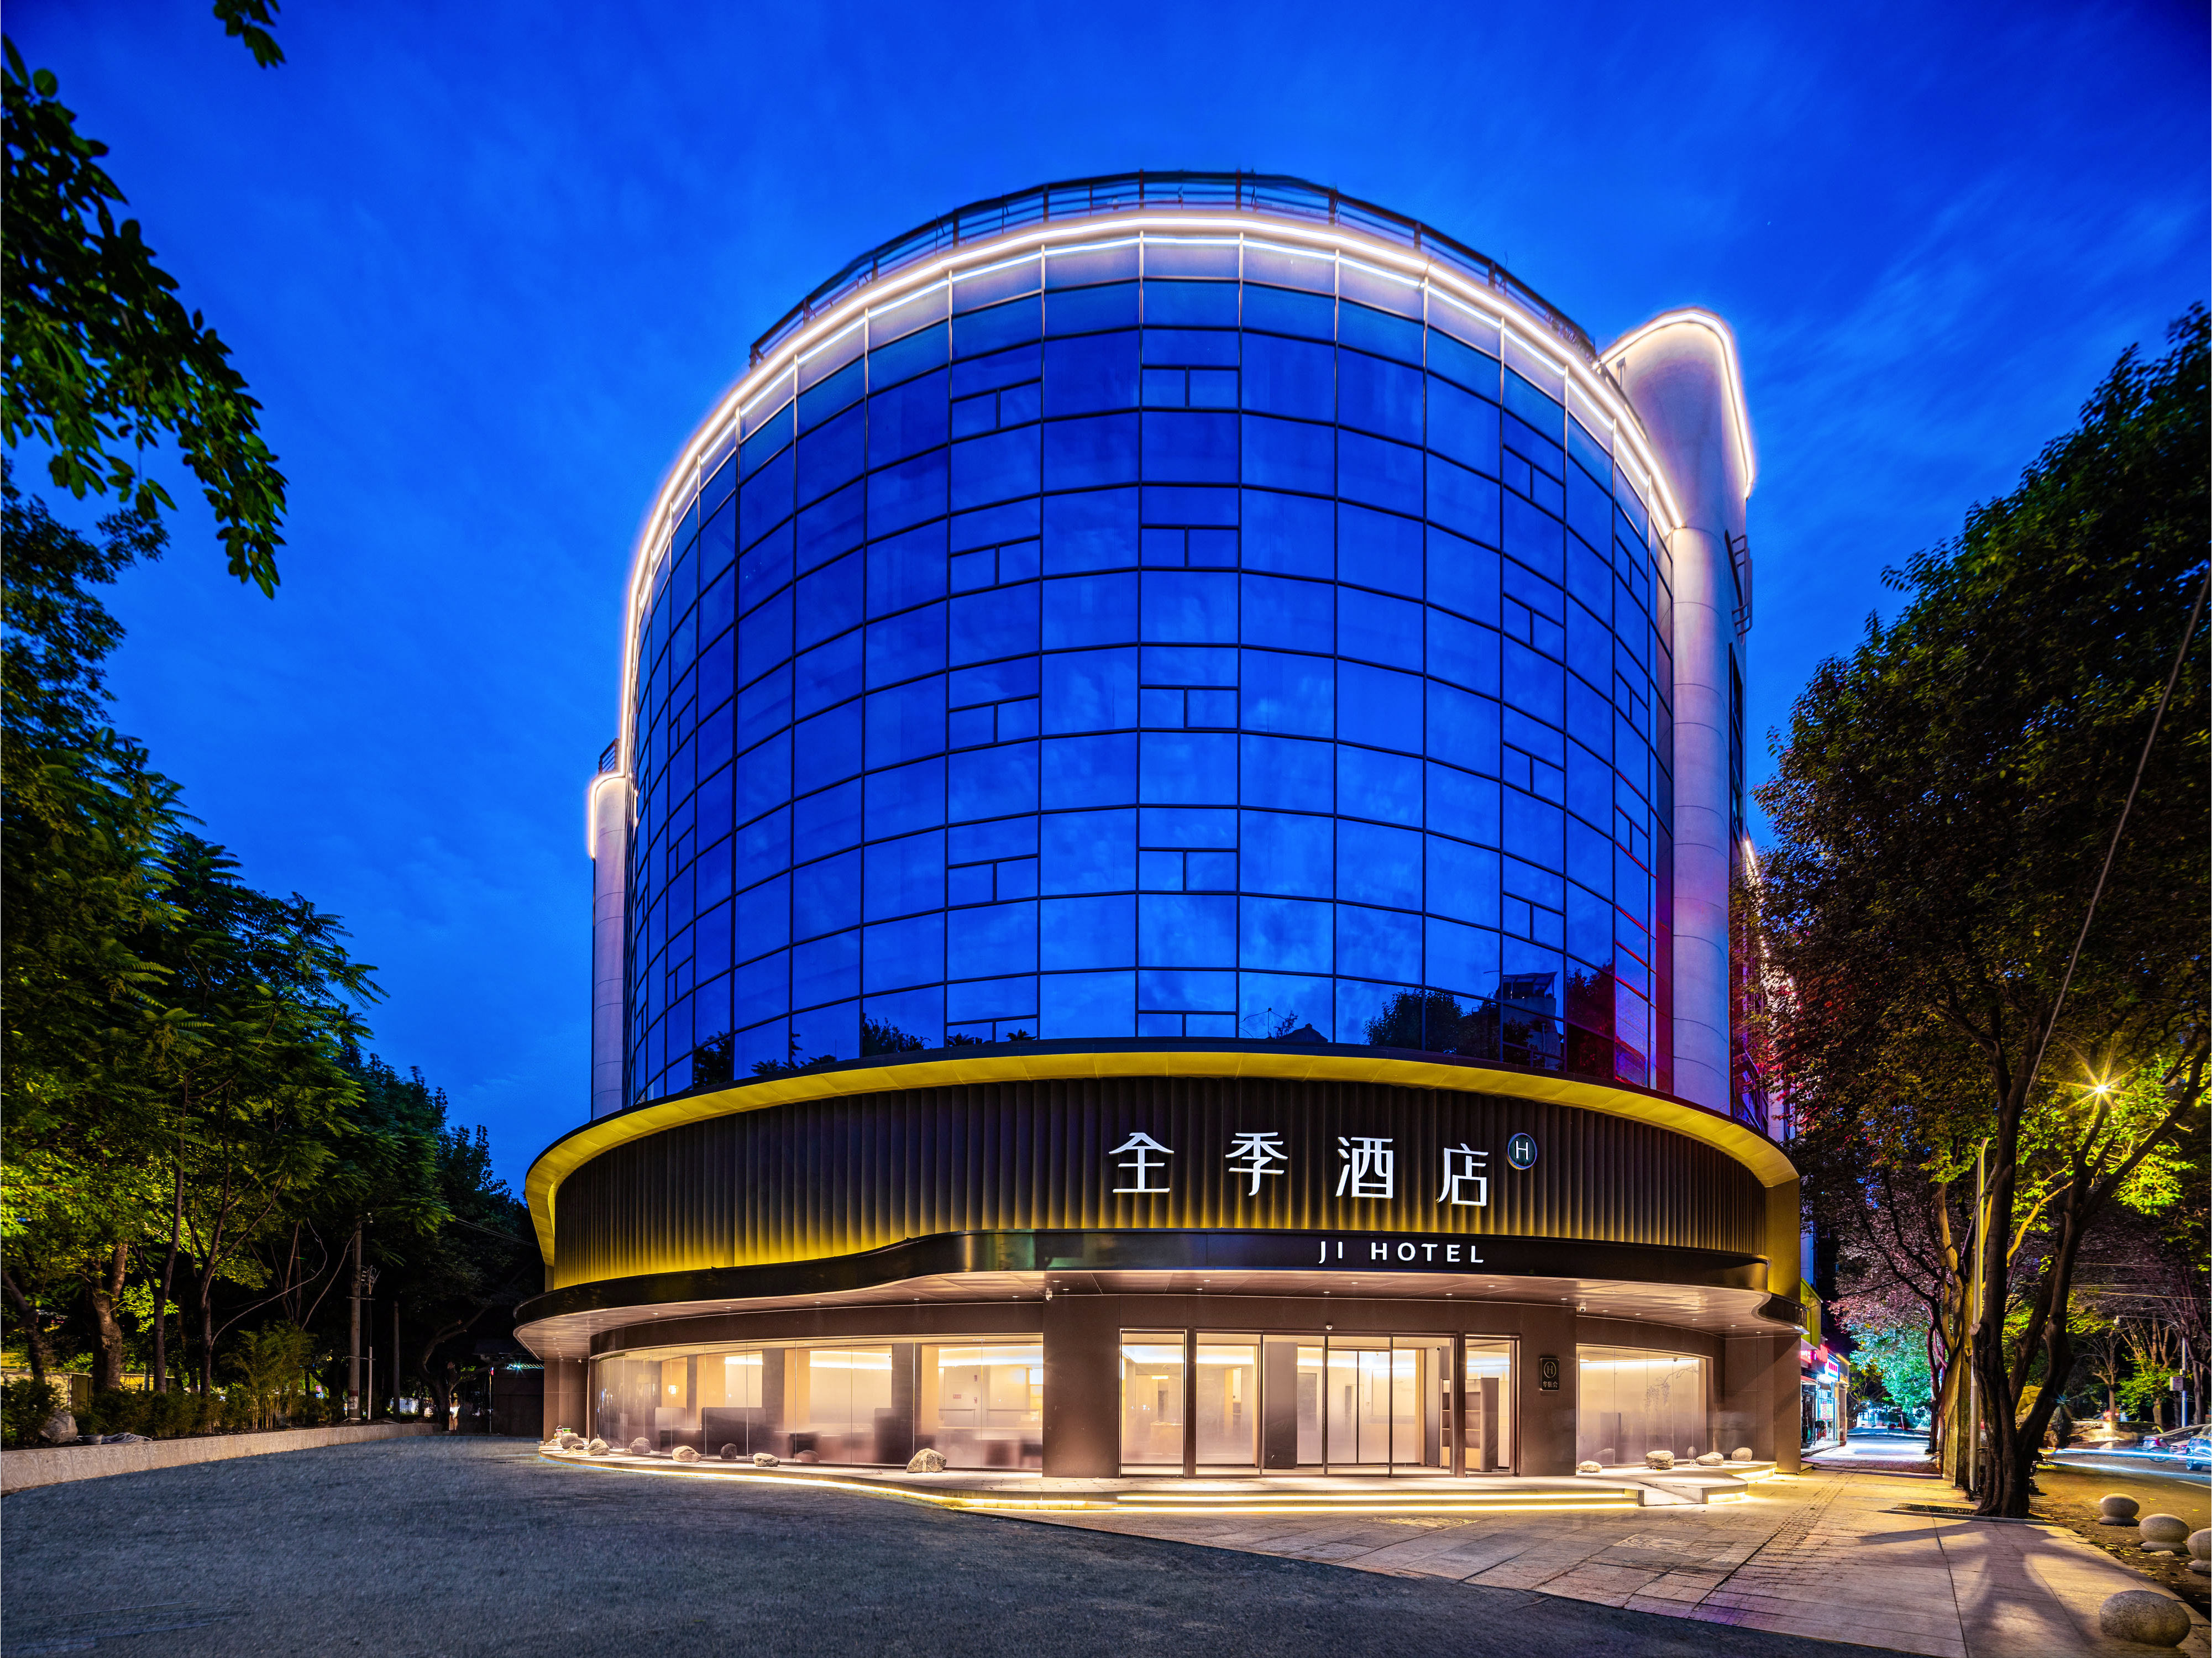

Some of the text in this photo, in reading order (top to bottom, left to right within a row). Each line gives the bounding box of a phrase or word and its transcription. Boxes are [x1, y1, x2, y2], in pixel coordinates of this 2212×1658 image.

[1516, 1140, 1529, 1160] H
[1108, 1132, 1488, 1206] 全季酒店
[1319, 1241, 1484, 1263] JI HOTEL
